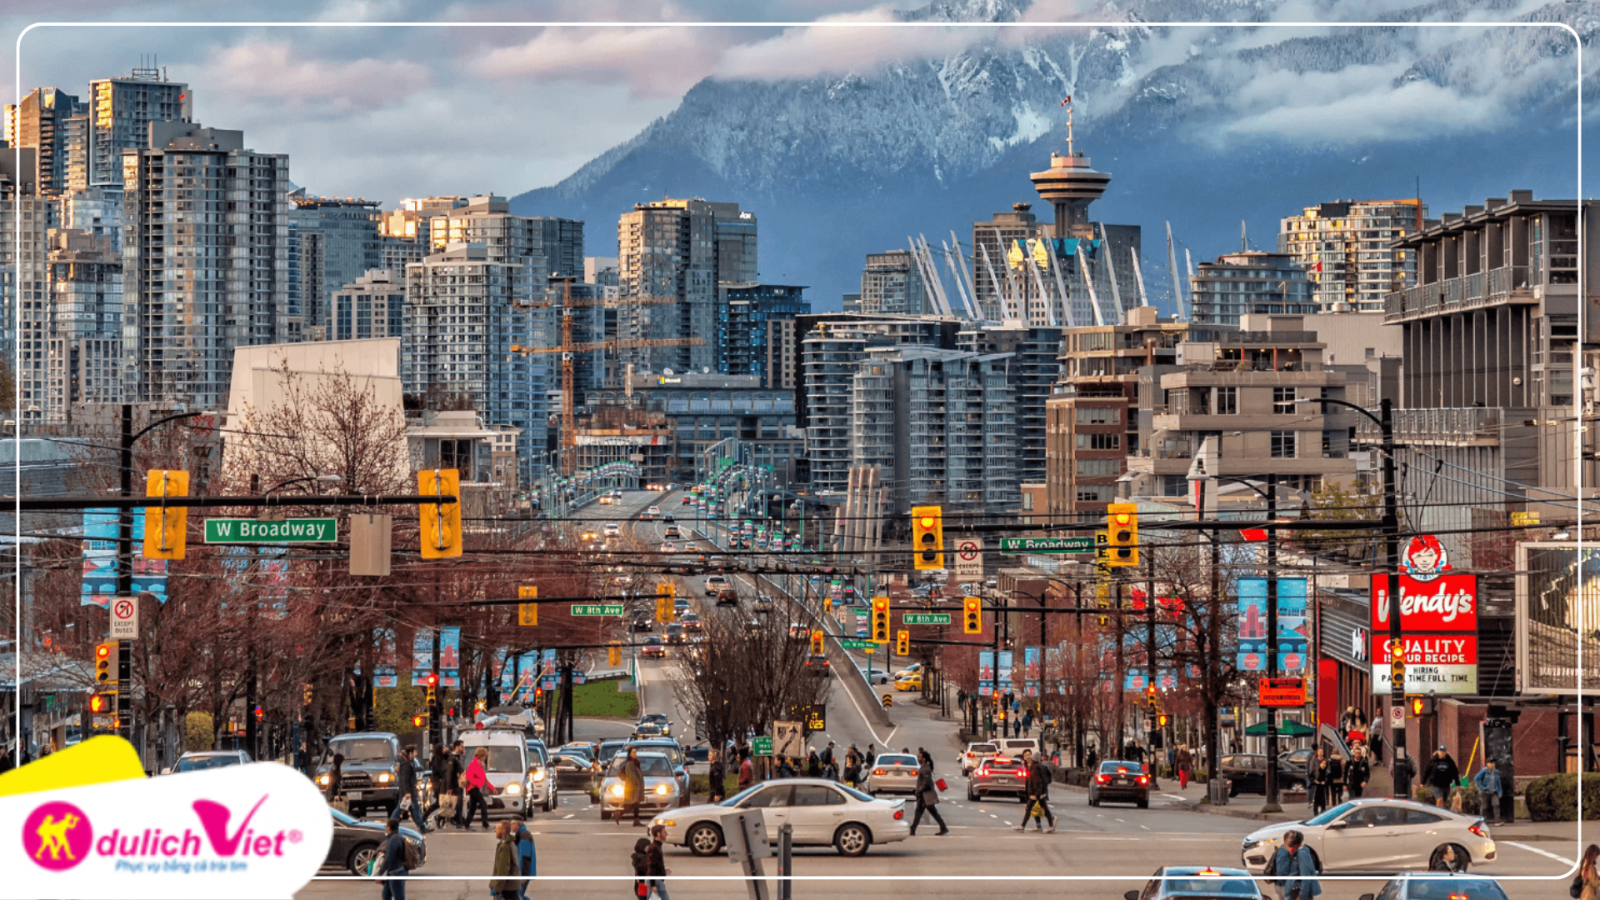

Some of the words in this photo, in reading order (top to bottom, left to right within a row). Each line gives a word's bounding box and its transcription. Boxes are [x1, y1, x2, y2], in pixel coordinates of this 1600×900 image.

[216, 522, 232, 536] W
[240, 521, 326, 540] Broadway
[1007, 539, 1021, 549] W
[1025, 539, 1089, 551] Broadway
[575, 606, 584, 614] W
[587, 606, 601, 614] 8th
[604, 606, 620, 614] Ave
[1404, 654, 1422, 662] UR
